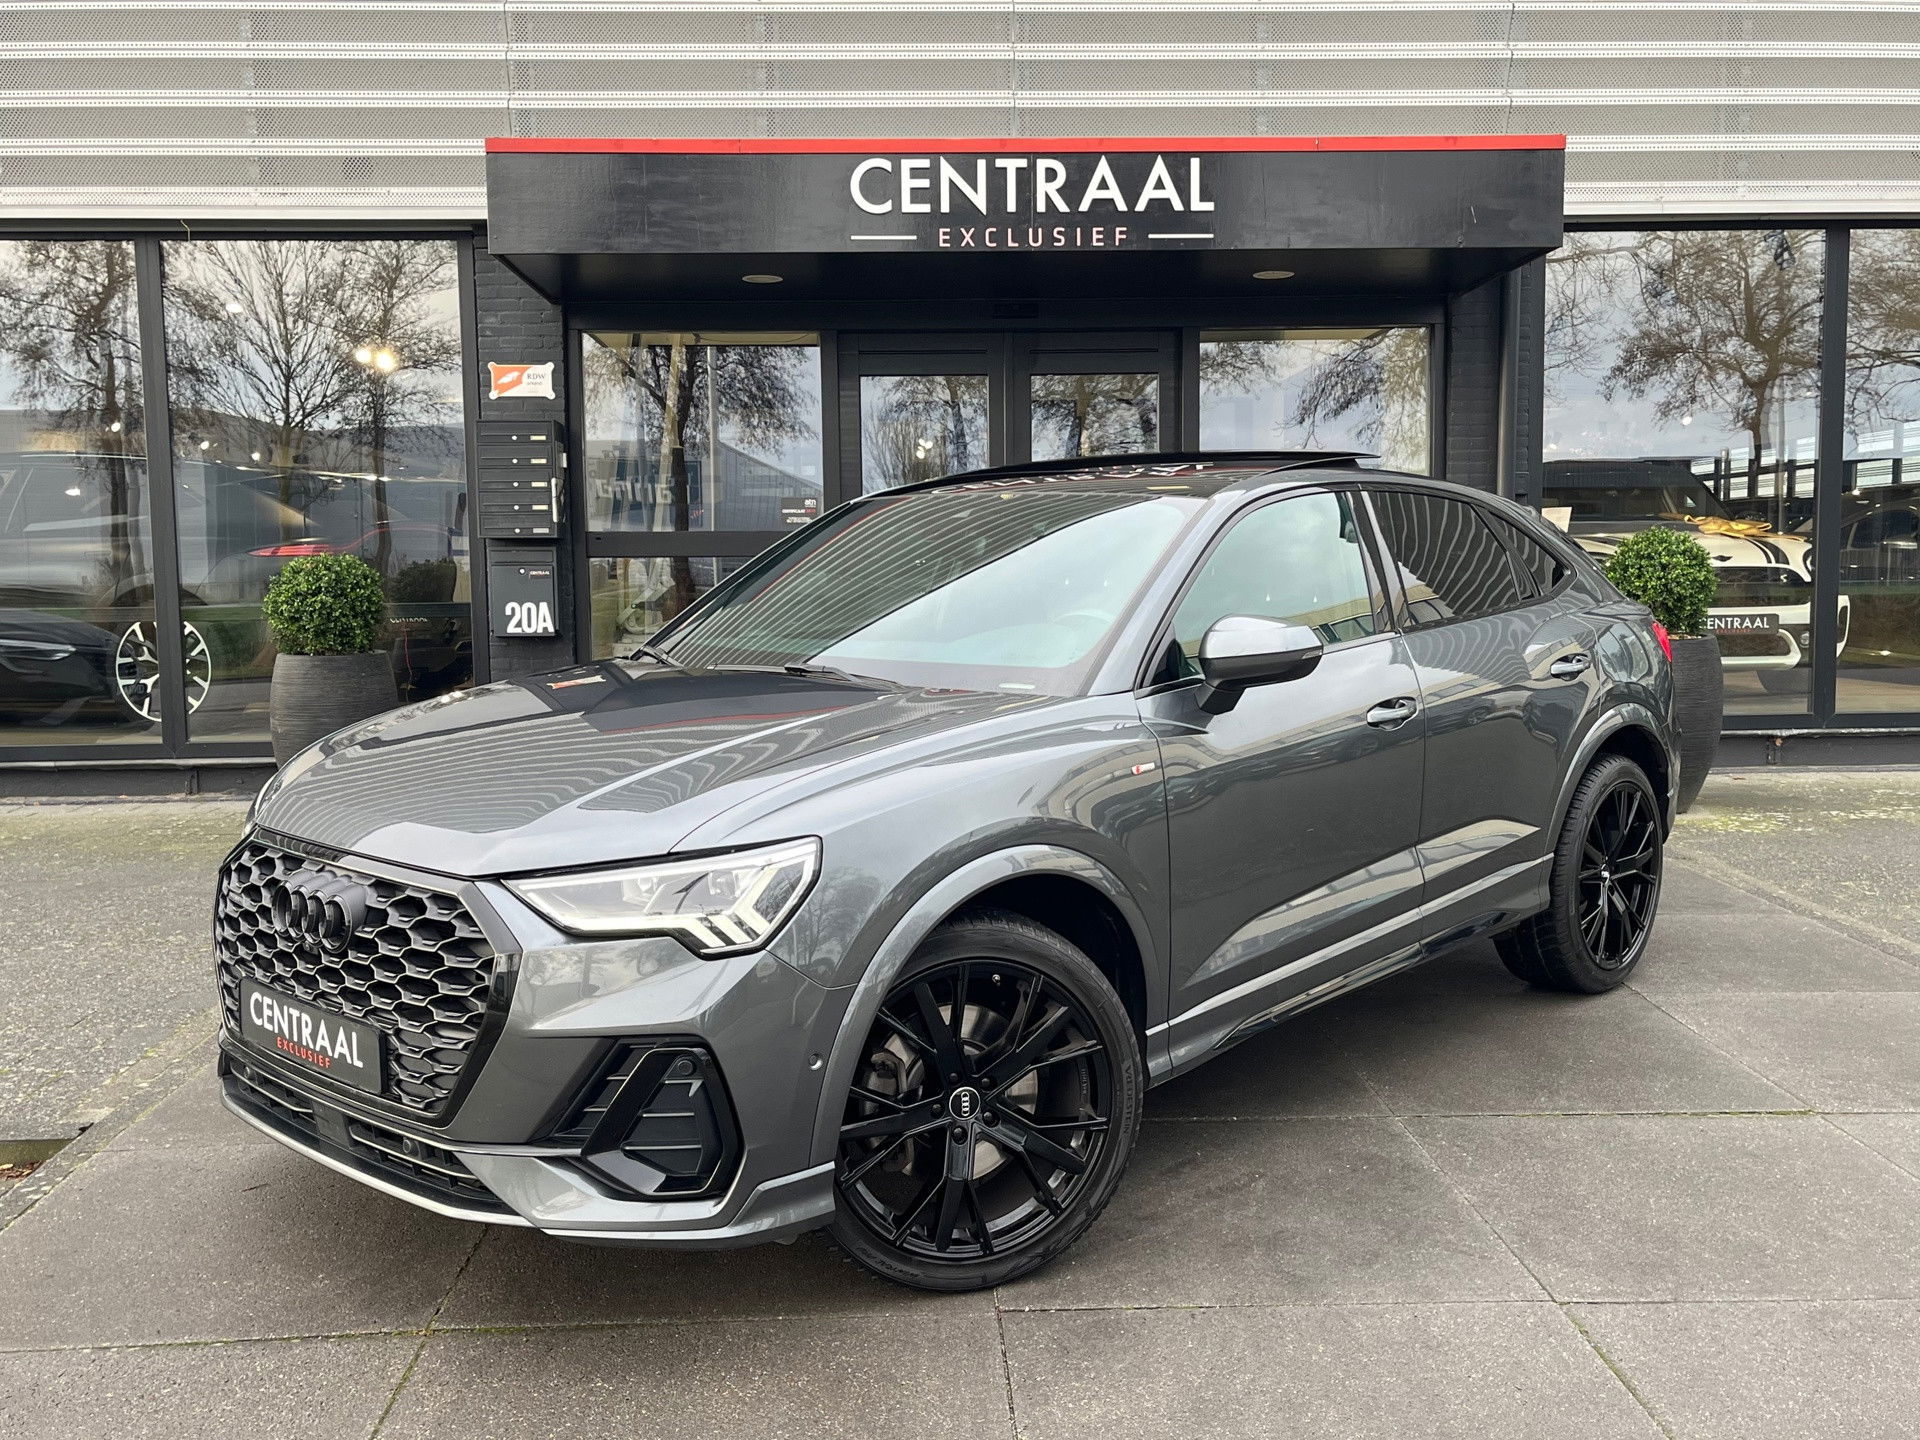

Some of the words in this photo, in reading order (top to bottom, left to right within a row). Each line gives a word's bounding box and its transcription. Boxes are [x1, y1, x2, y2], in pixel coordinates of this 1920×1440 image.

[850, 154, 1215, 216] CENTRAAL
[938, 226, 1128, 248] EXCLUSIEF
[505, 601, 555, 634] 20A
[250, 991, 364, 1068] CENTRAAL
[276, 1036, 332, 1069] EXCLUSIEF
